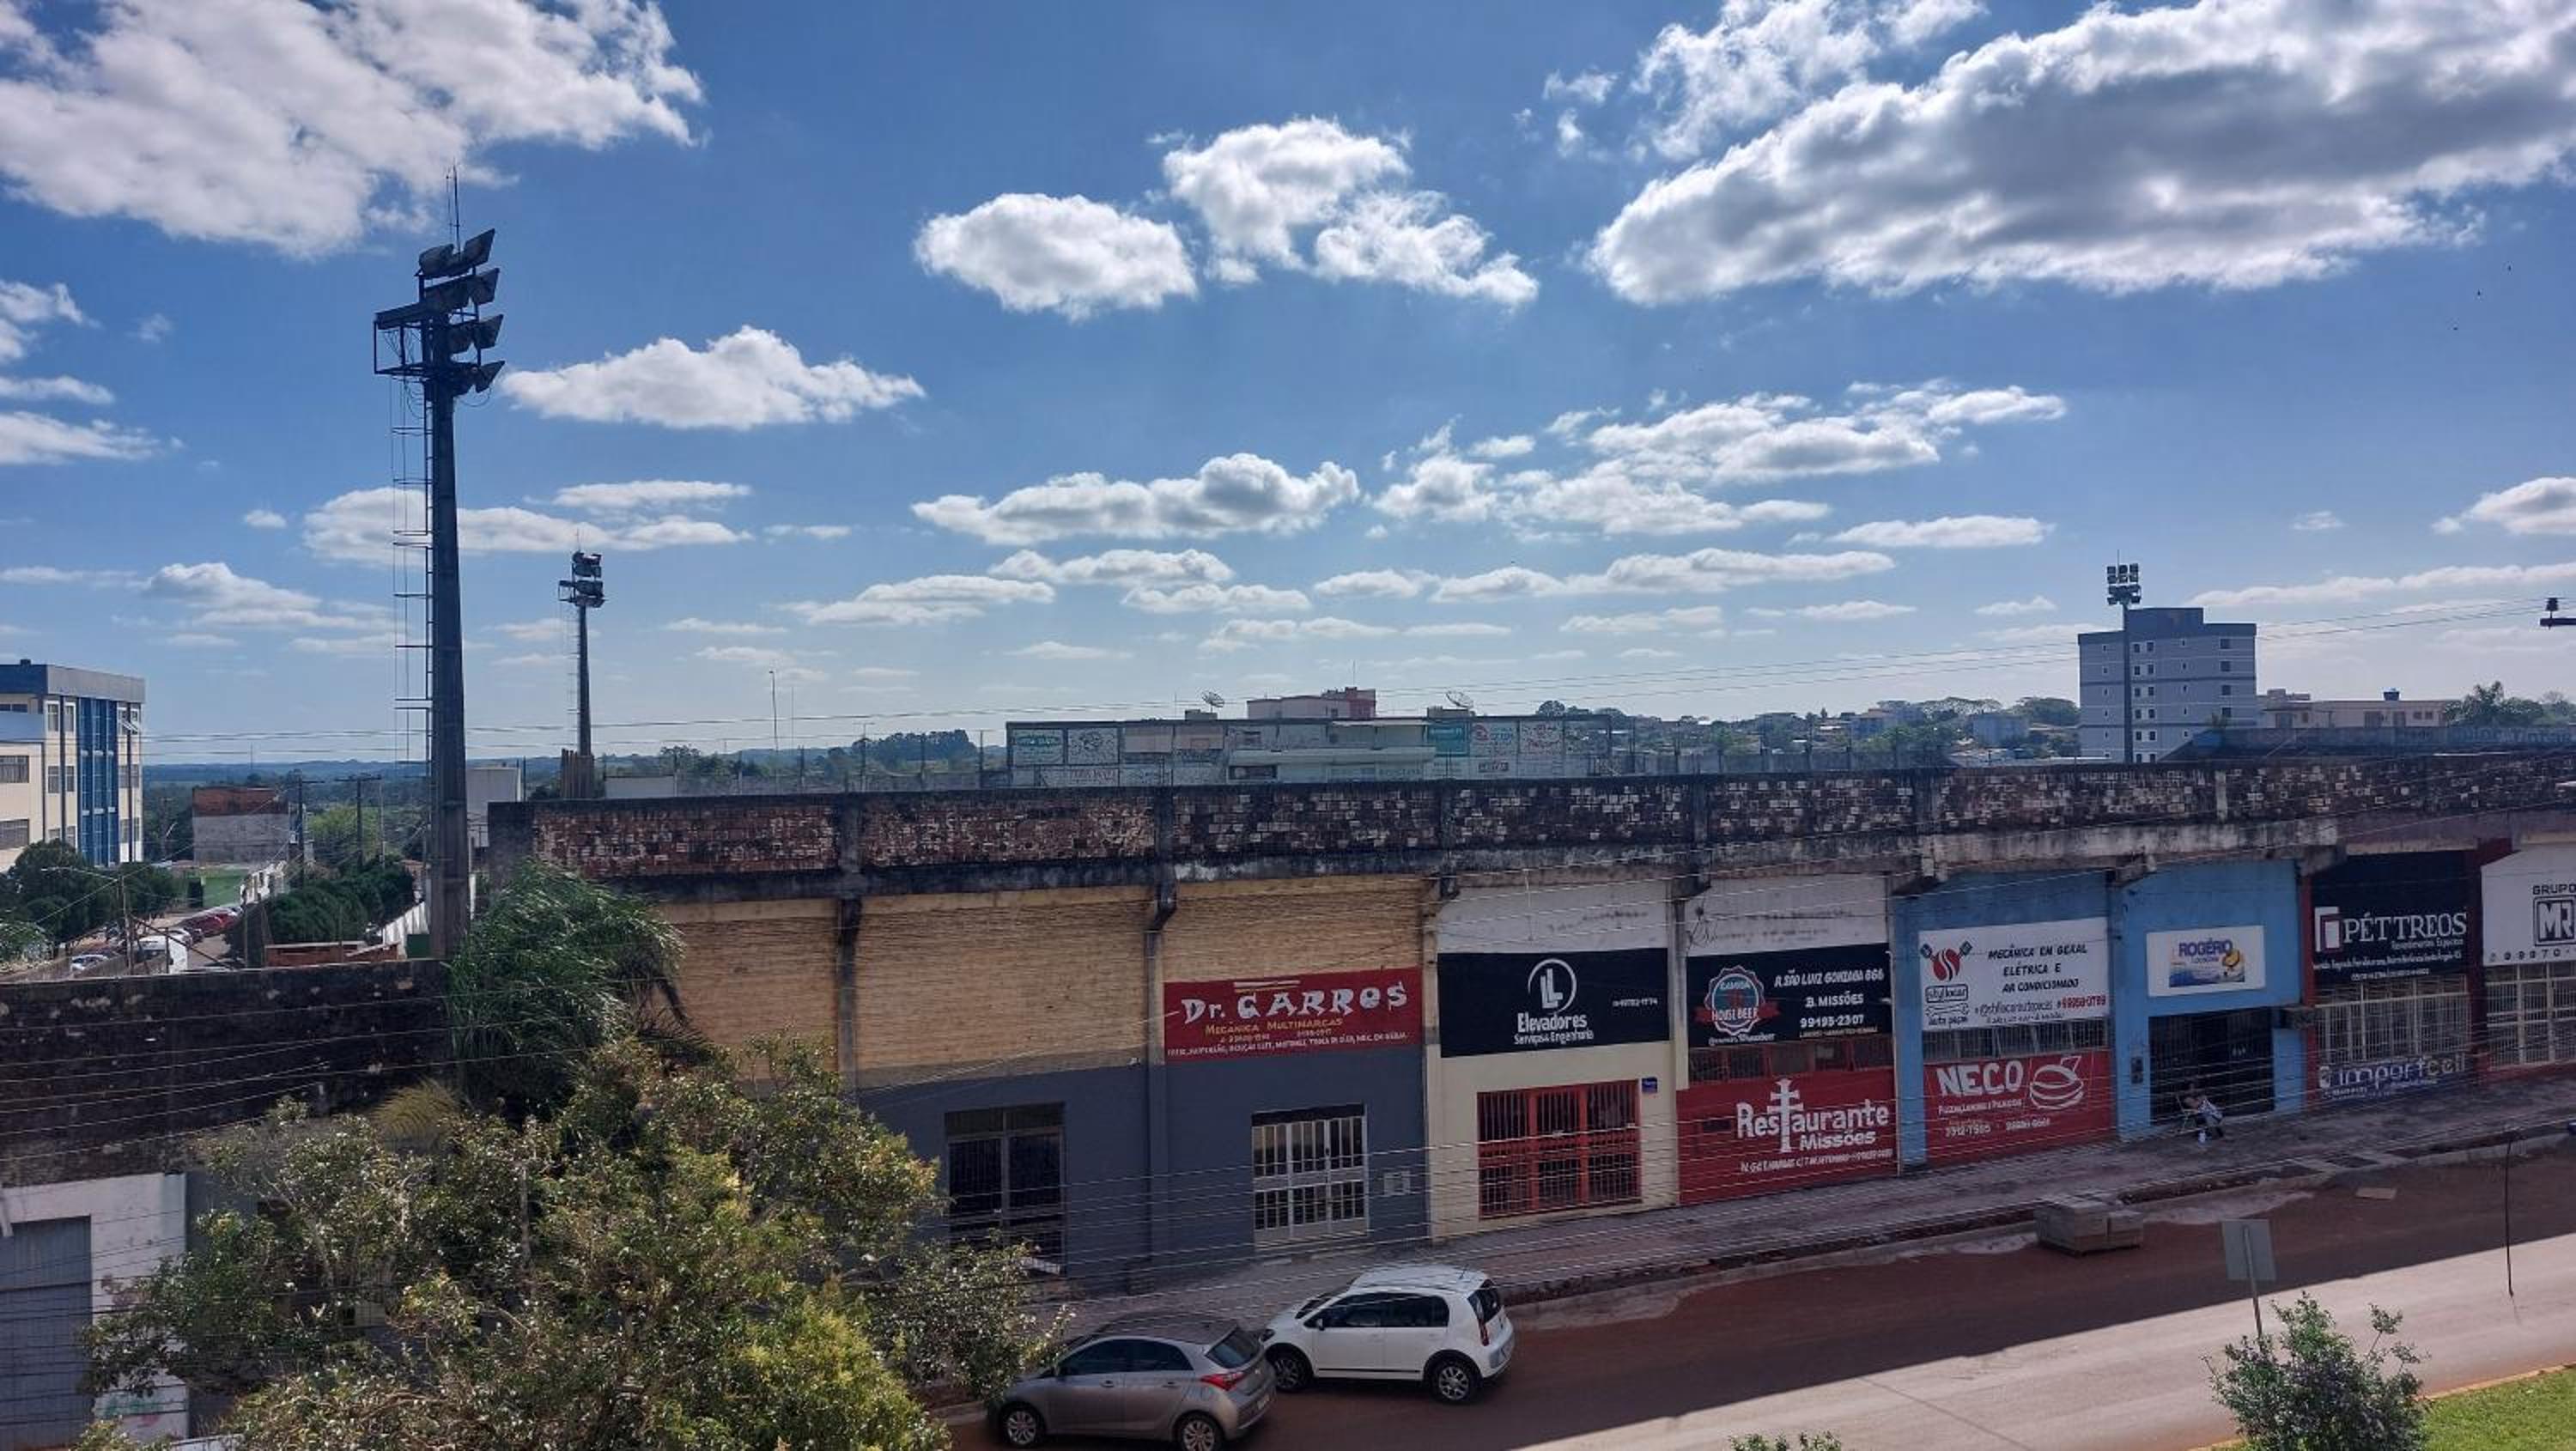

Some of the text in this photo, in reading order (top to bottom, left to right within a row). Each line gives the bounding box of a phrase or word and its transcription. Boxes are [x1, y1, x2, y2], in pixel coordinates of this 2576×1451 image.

[2342, 912, 2468, 944] PÉTTREOS
[1988, 944, 2087, 960] MECÂNICA EM GERAL
[2179, 937, 2233, 957] ROGÉRIO
[1801, 971, 1823, 985] LUIZ
[1824, 970, 1863, 984] GONZAGA
[2003, 961, 2061, 977] ELÉTRICA E
[2002, 978, 2079, 993] AR CONDICIONADO
[1804, 991, 1864, 1009] B. MISSÕES
[1181, 999, 1225, 1024] Dr.
[1516, 1011, 1589, 1034] Elevadores
[1936, 1060, 2025, 1097] NECO
[1736, 1084, 1889, 1150] Restaurante
[1800, 1130, 1877, 1151] Missões
